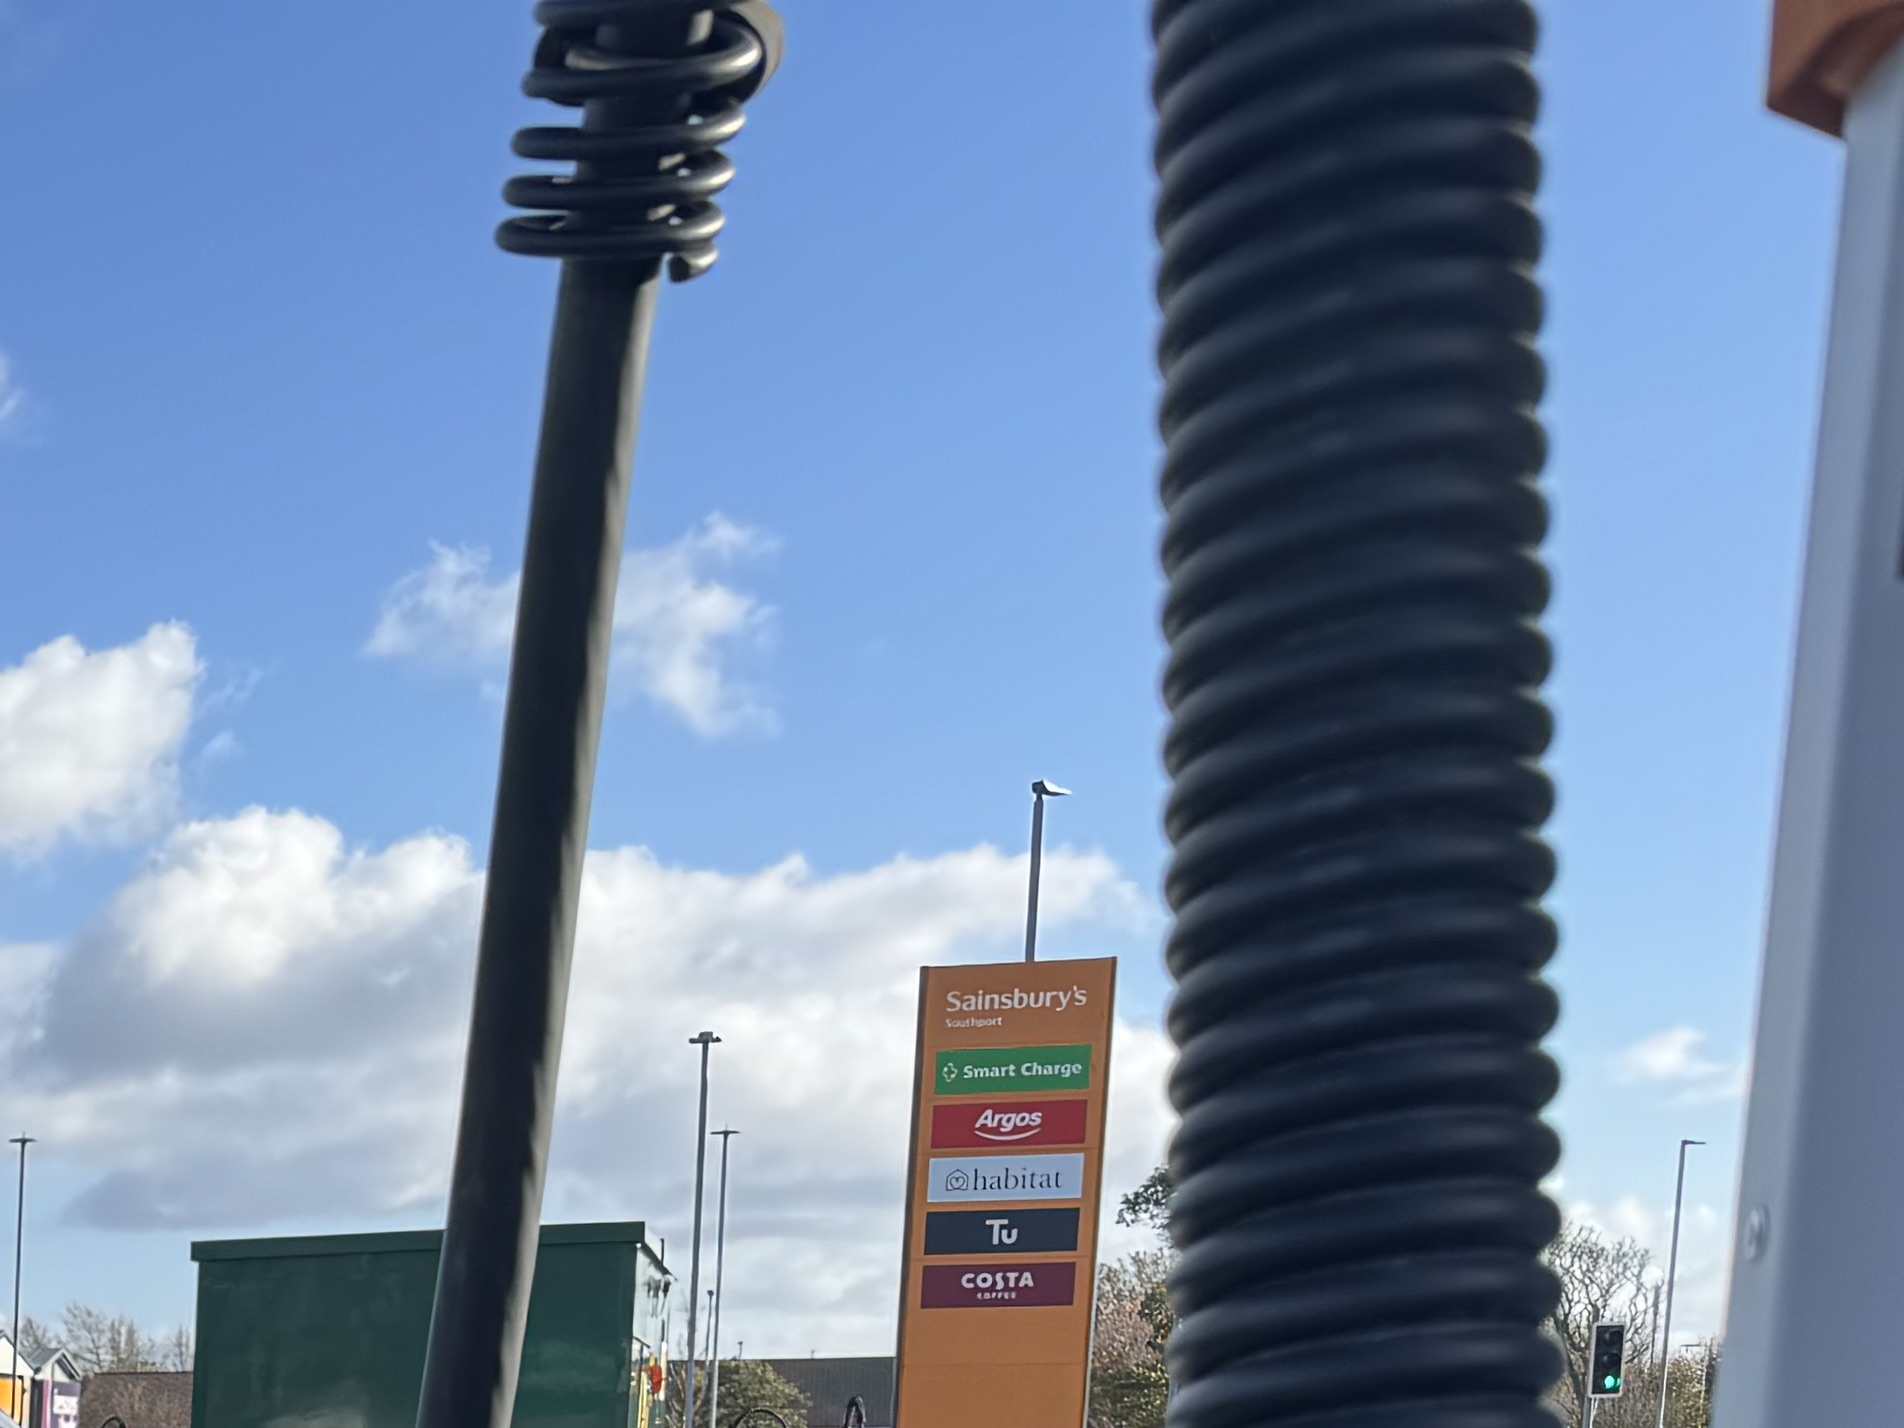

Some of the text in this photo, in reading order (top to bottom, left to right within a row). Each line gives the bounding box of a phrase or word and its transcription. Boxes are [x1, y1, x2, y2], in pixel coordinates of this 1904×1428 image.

[946, 985, 1087, 1012] Sainsbury's
[963, 1062, 1082, 1078] Smart Charge
[974, 1109, 1043, 1132] Argos
[973, 1167, 1063, 1191] habitat
[985, 1219, 1018, 1245] Tu
[961, 1271, 1034, 1290] COSTA
